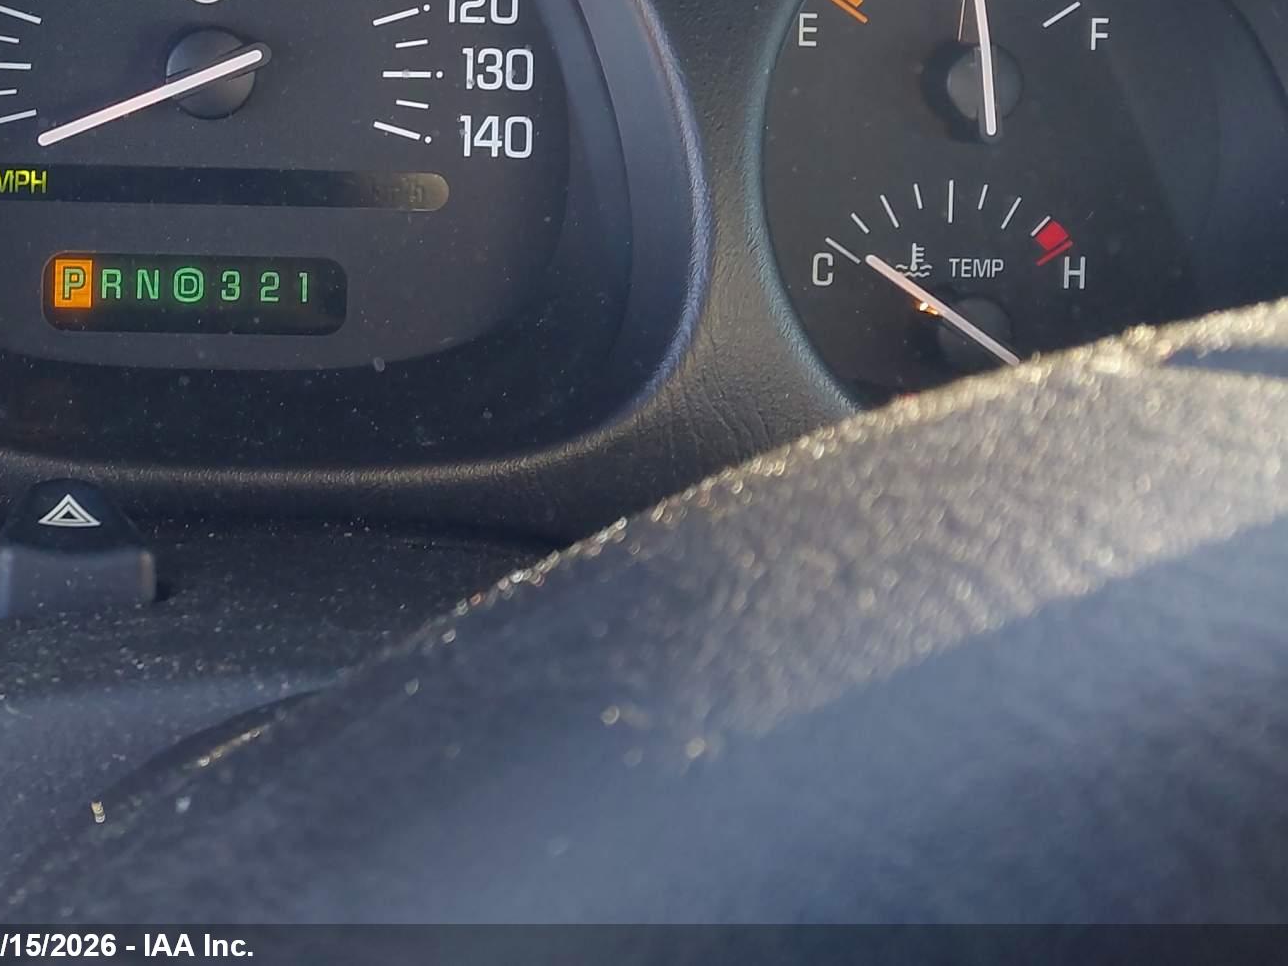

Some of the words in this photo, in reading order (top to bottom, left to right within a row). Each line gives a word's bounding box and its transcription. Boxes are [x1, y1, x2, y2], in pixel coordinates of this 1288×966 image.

[799, 13, 817, 46] E
[1091, 18, 1108, 50] F
[463, 48, 533, 90] 130
[460, 115, 532, 158] 140
[62, 266, 86, 300] P
[102, 269, 121, 298] R
[137, 270, 159, 299] N
[222, 271, 240, 300] 3
[261, 272, 279, 301] 2
[813, 253, 833, 285] C
[949, 259, 1003, 277] TEMP
[1064, 257, 1085, 289] H
